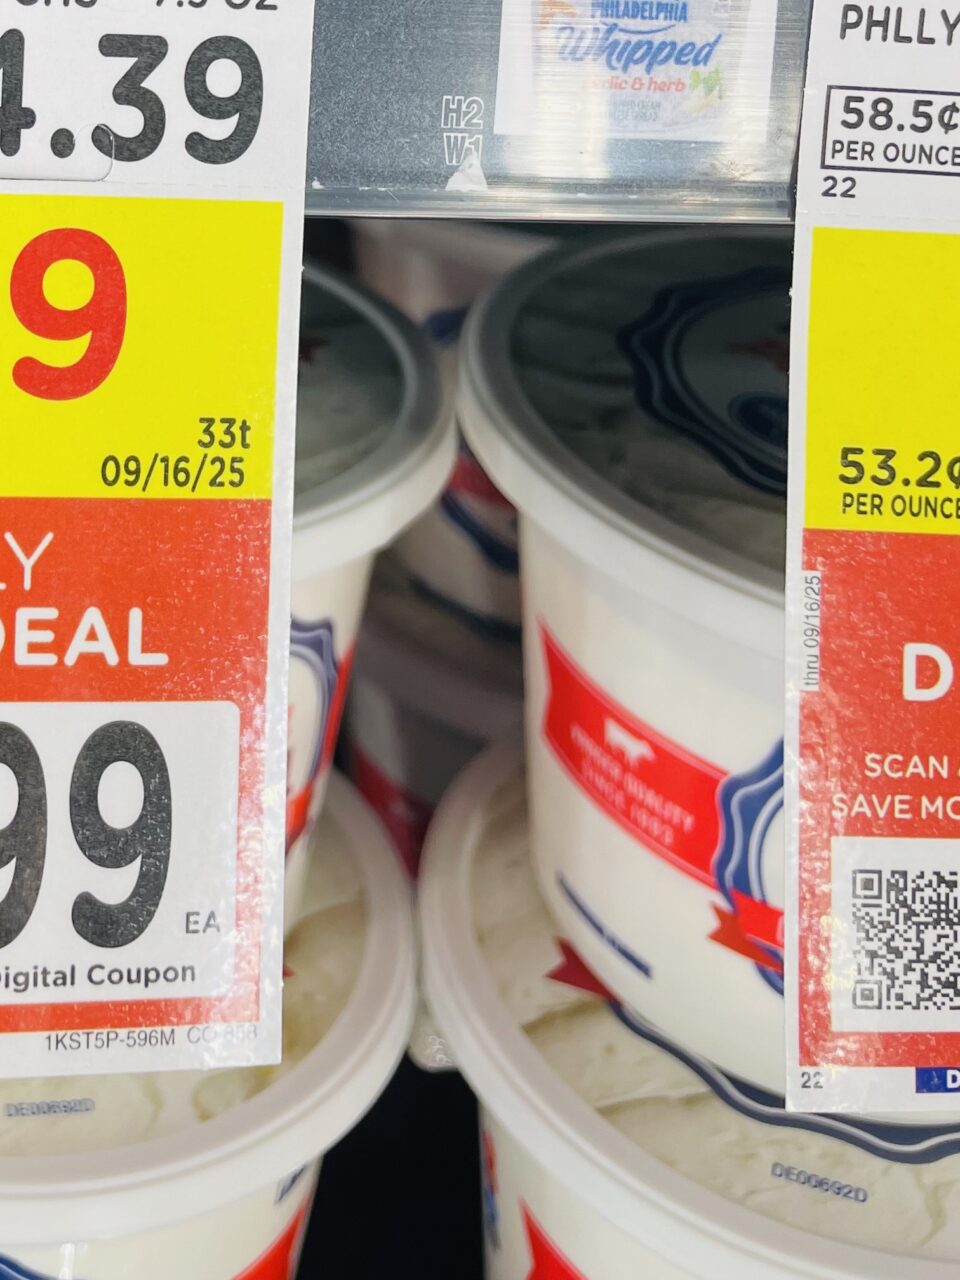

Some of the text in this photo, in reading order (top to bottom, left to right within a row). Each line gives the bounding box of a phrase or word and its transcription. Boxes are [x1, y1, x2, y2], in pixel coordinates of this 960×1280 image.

[591, 0, 688, 24] PHILADELPHIA
[839, 3, 960, 46] PHLLY
[554, 22, 722, 74] Whipped
[631, 75, 686, 93] & herb
[441, 95, 484, 129] H2
[443, 132, 483, 166] W1
[831, 139, 960, 167] PER OUNCE
[821, 175, 857, 199] 22
[197, 417, 251, 449] 33t
[100, 453, 245, 493] 09/16/25
[842, 492, 960, 519] PER OUNCE
[803, 575, 821, 687] thru 09/16/25
[902, 643, 954, 702] D
[864, 753, 948, 779] SCAN
[832, 793, 912, 819] SAVE
[185, 910, 221, 934] EA
[87, 964, 195, 989] Coupon
[46, 1028, 175, 1050] 1KST5P-596M
[801, 1072, 823, 1089] 22
